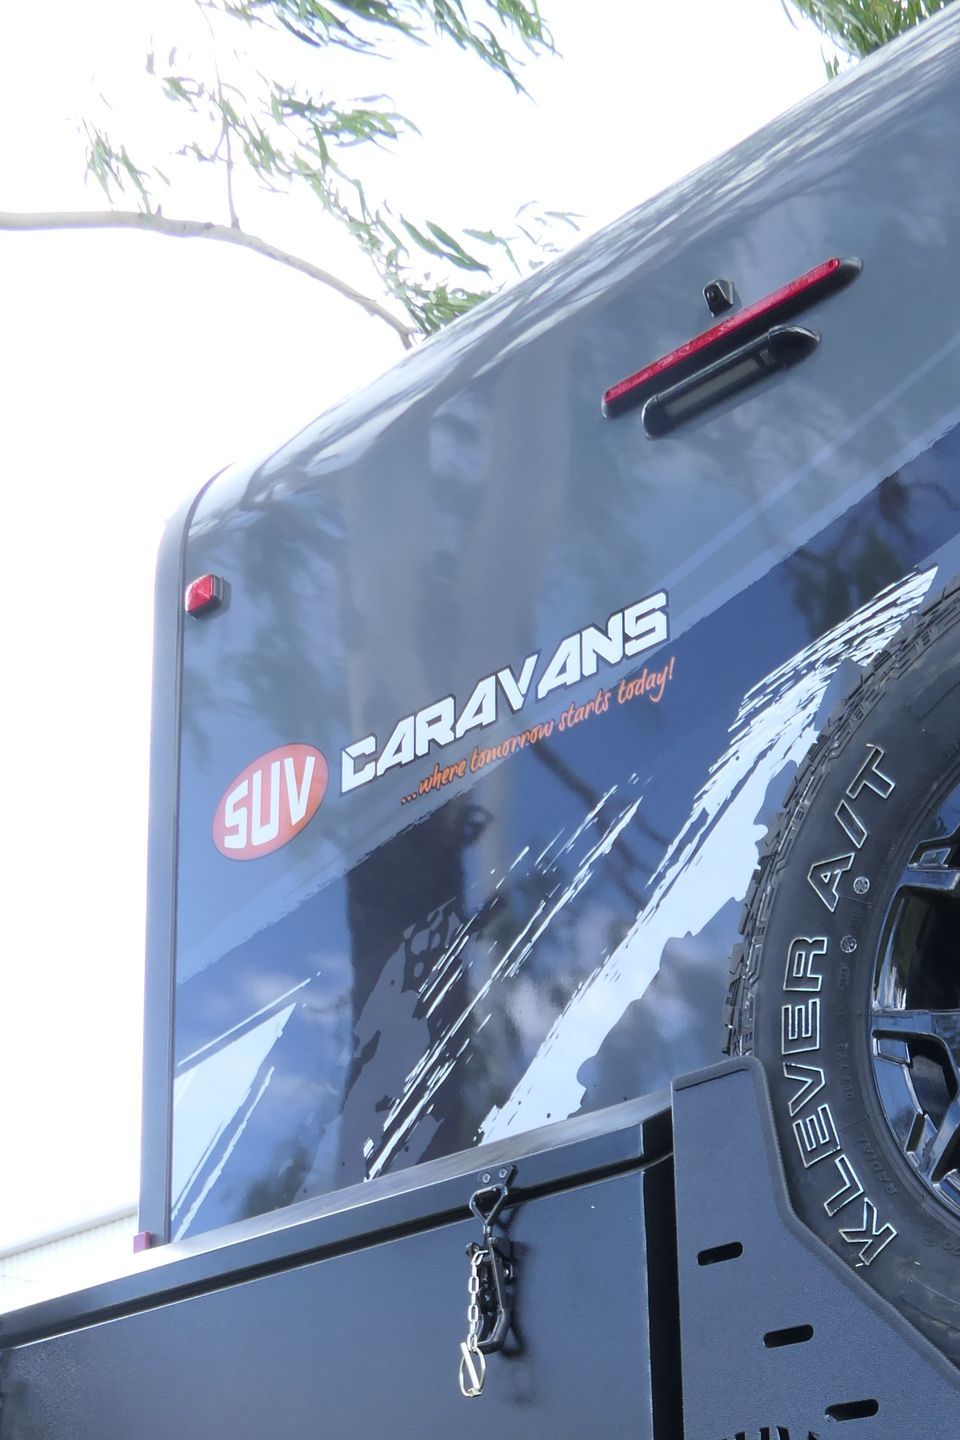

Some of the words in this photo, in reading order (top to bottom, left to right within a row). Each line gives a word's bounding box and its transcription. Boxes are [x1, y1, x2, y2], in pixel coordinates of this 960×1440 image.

[341, 590, 668, 794] CARAVANS
[470, 721, 554, 772] tomorrow
[558, 690, 611, 732] starts
[618, 656, 676, 702] today!
[223, 755, 316, 850] SUV
[806, 743, 896, 913] A/T
[781, 934, 898, 1267] KLEVER
[861, 1134, 899, 1196] RADIAL
